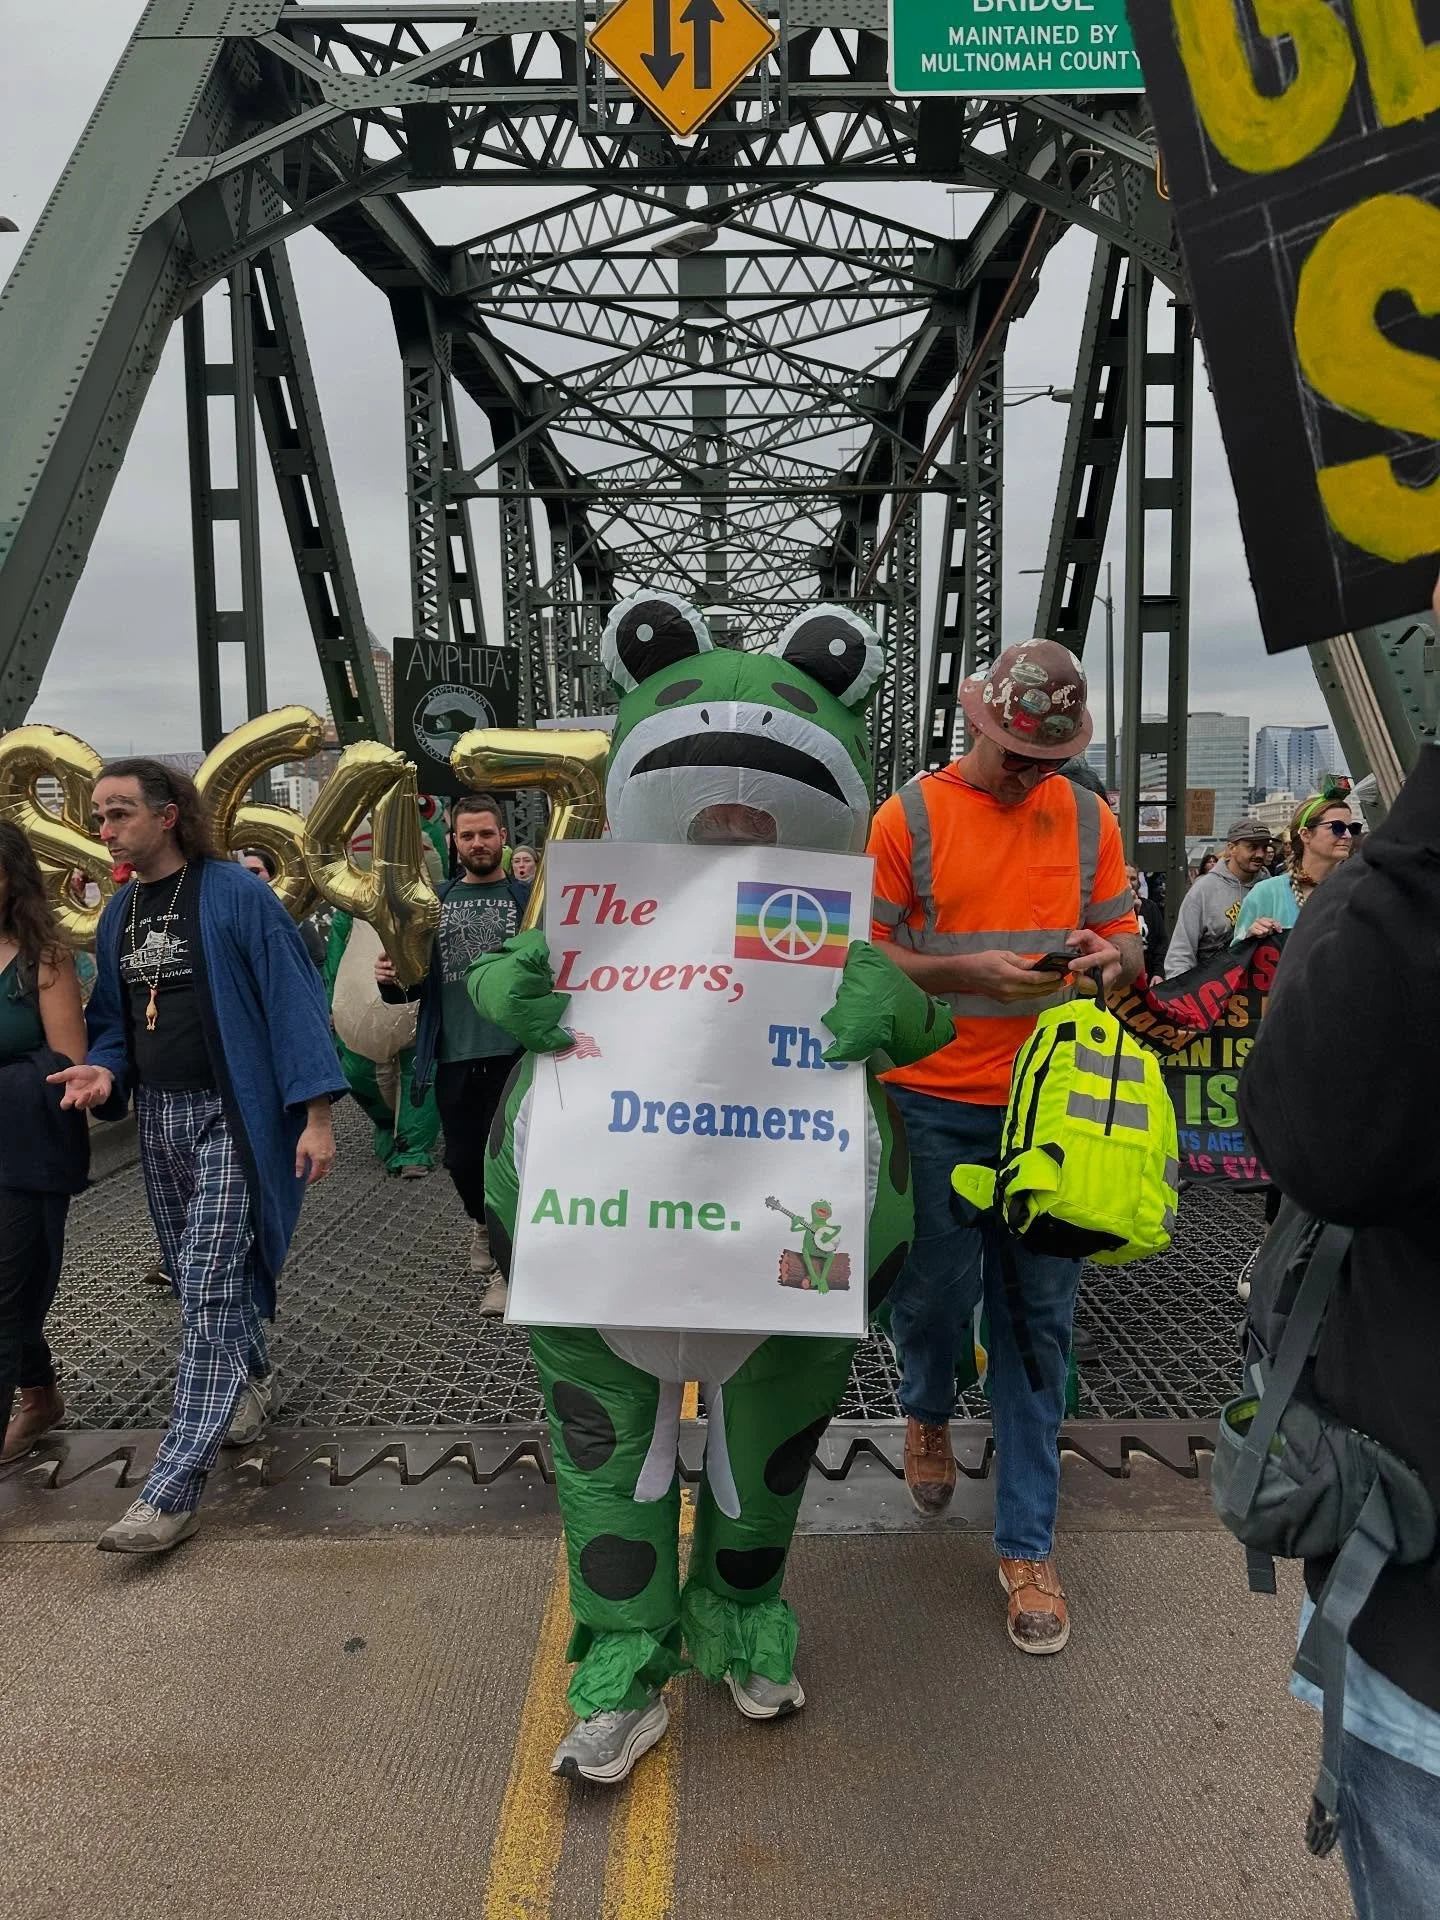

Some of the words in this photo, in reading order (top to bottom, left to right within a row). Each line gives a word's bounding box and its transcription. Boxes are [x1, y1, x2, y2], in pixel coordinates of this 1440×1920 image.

[949, 25, 1080, 46] MAINTAINED
[1090, 24, 1119, 44] BY
[921, 51, 1051, 73] MULTNOMAH
[441, 899, 517, 910] NURTURE
[560, 883, 658, 928] The
[553, 950, 744, 1003] Lovers,
[768, 1024, 849, 1071] Th
[608, 1090, 850, 1153] Dreamers,
[1185, 1074, 1240, 1128] IS
[1207, 1131, 1245, 1152] ARE
[531, 1188, 629, 1229] And
[648, 1198, 742, 1232] me.
